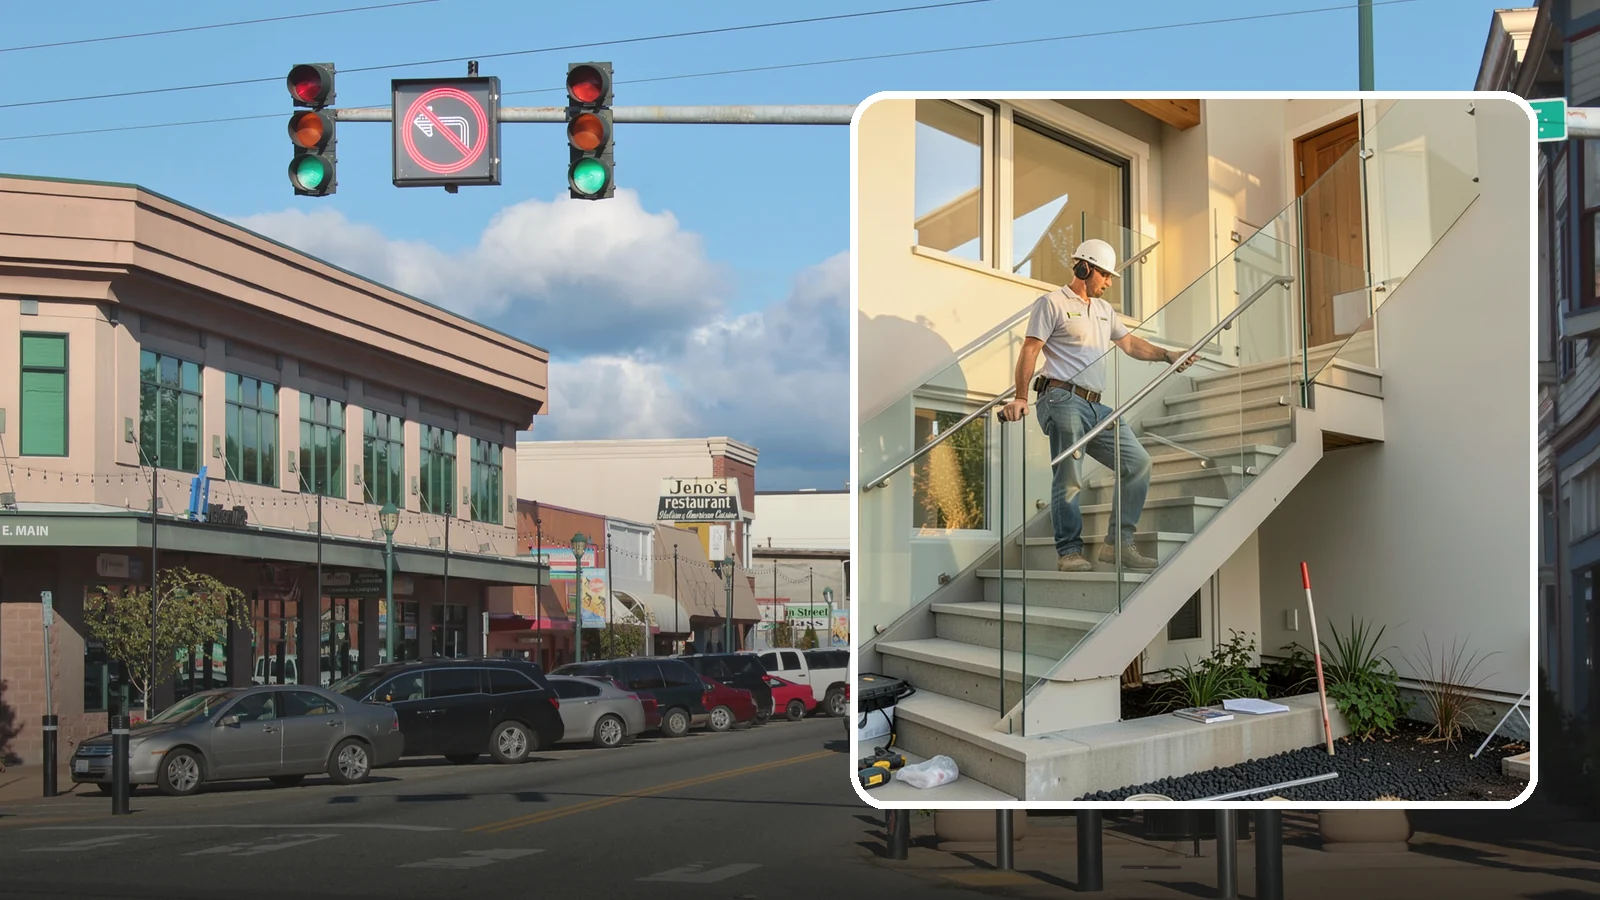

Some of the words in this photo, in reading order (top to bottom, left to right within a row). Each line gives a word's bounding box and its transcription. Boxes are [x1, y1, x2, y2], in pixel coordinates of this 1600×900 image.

[670, 480, 727, 494] Jeno's
[665, 496, 731, 509] restaurant
[686, 510, 714, 519] American
[715, 510, 737, 519] Cuisine
[2, 525, 13, 536] E.
[15, 525, 49, 536] MAIN
[797, 607, 828, 617] Street
[791, 619, 823, 627] lass
